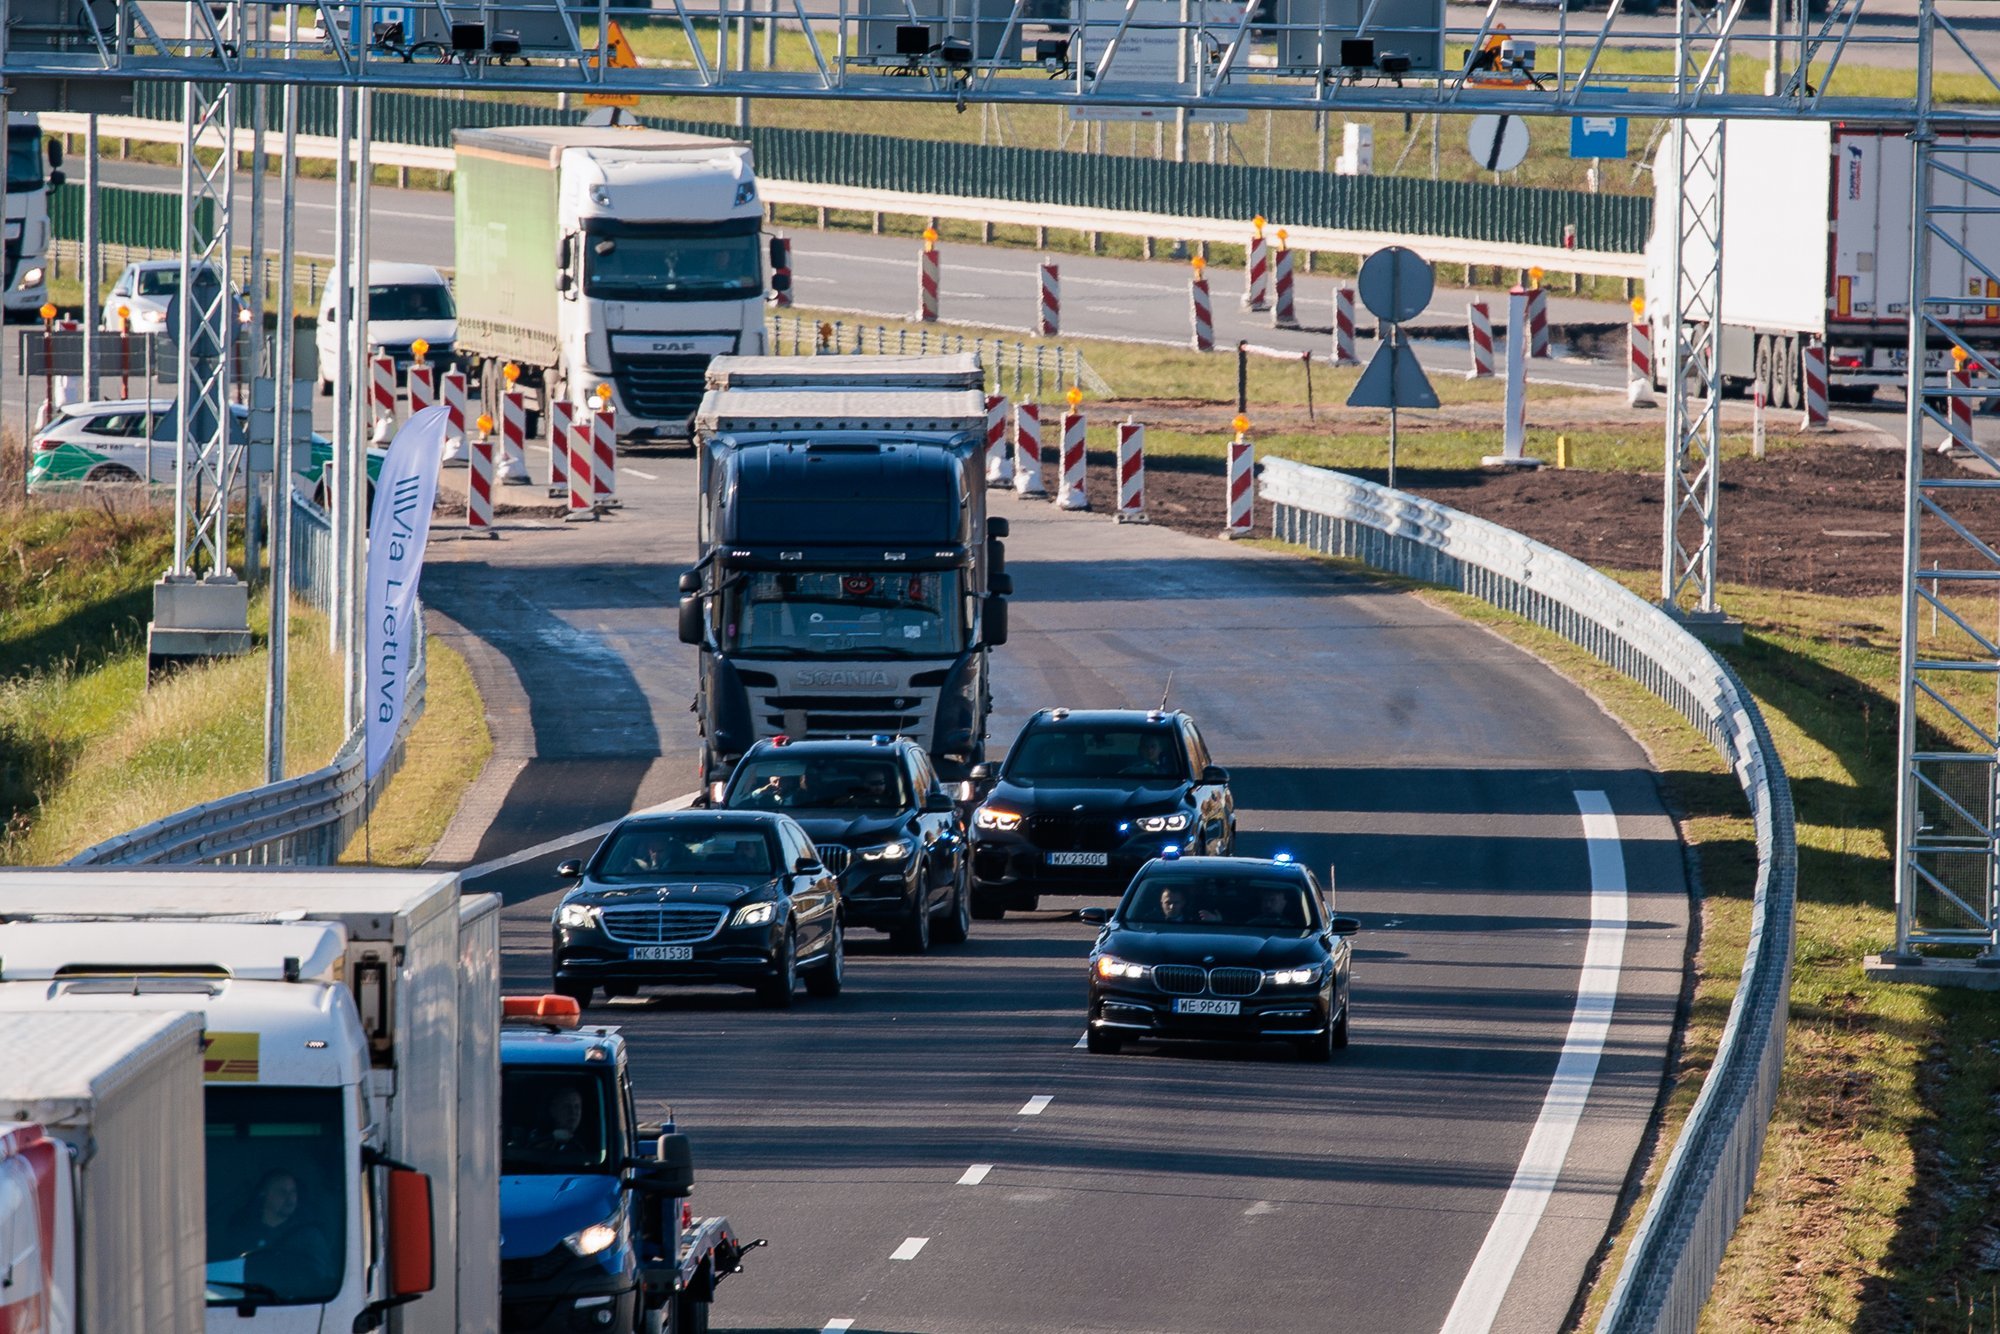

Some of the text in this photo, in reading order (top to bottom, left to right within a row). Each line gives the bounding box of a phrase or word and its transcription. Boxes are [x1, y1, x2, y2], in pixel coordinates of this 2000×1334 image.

[652, 342, 695, 351] DAF
[379, 503, 417, 723] Via Lietuva
[797, 670, 890, 686] SCANIA
[1054, 853, 1068, 865] WX
[635, 947, 690, 959] WK 81538
[1180, 1000, 1237, 1014] WE 9P617
